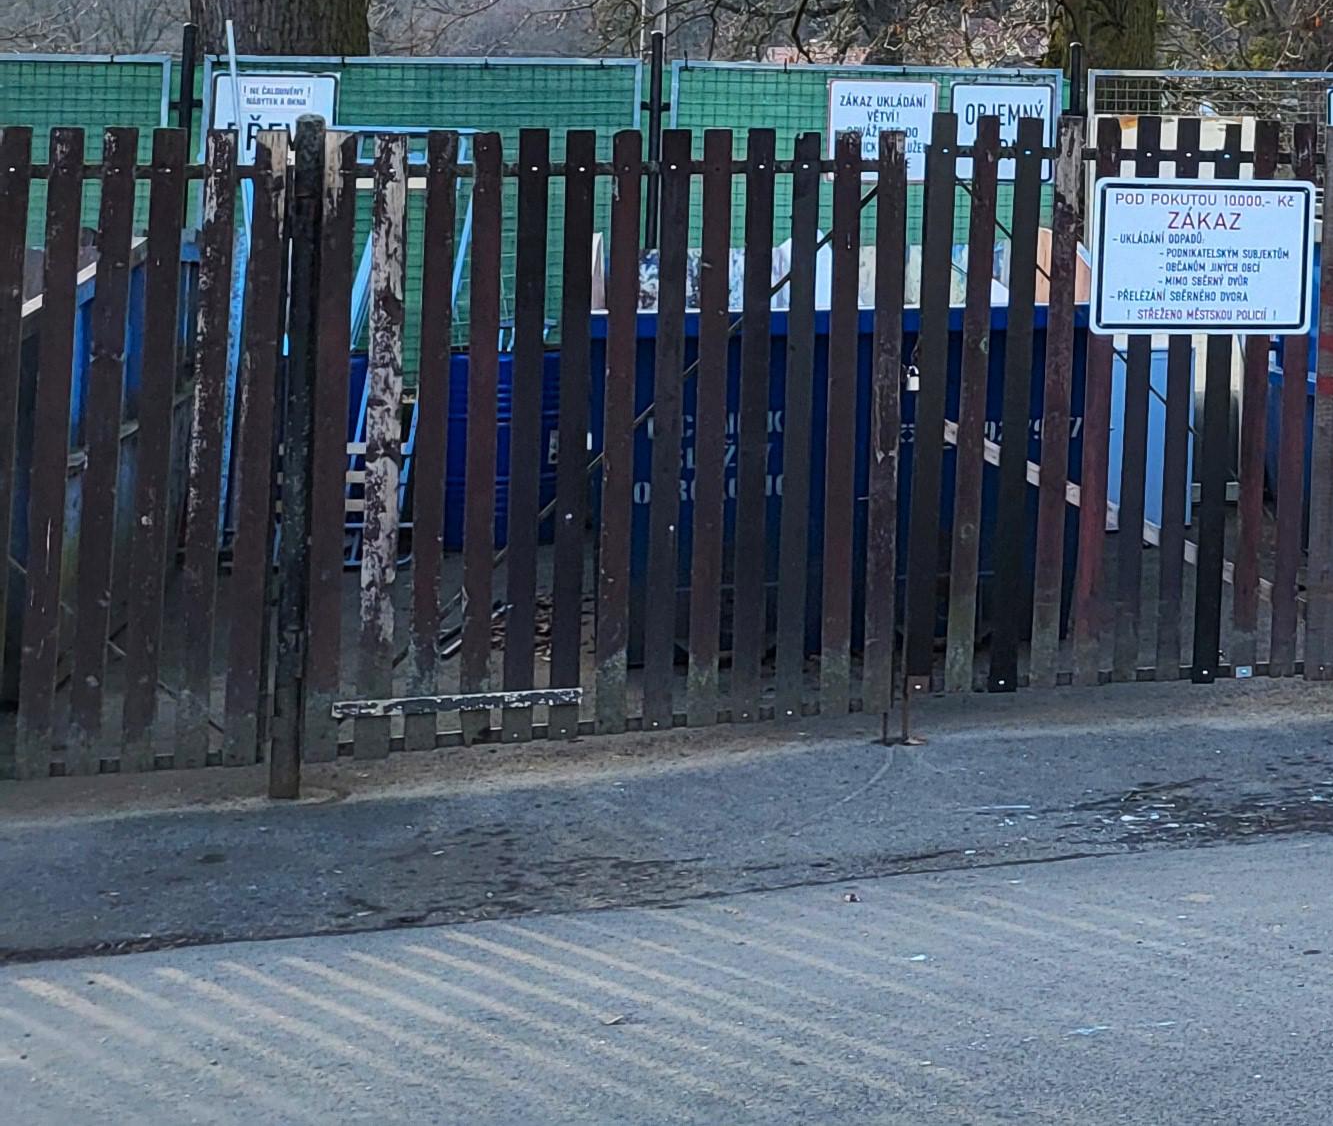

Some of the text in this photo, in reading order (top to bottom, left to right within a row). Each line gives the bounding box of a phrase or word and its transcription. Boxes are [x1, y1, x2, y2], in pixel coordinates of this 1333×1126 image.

[246, 95, 306, 106] NÁBYTEK A OKNA
[840, 92, 927, 108] ZÁKAZ UKLÁDÁNÍ
[867, 108, 899, 123] VĚTVÍ!
[1115, 193, 1145, 206] POD
[1151, 193, 1217, 206] POKUTOU
[1278, 195, 1295, 207] Kč
[1167, 207, 1242, 231] ZÁKAZ
[1120, 232, 1165, 244] UKLÁDÁNÍ
[1166, 247, 1239, 259] PODNIKATELSKÝM
[1242, 249, 1289, 259] SUBJEKTŮM
[1166, 262, 1206, 273] OBČANŮM
[1210, 262, 1238, 273] JINÝCH
[1165, 276, 1188, 286] MIMO
[1191, 274, 1224, 286] SBĚRNÝ
[1228, 274, 1249, 286] DVŮR
[1117, 289, 1166, 301] PŘELÉZÁNÍ
[1170, 290, 1216, 301] SBĚRNÉHO
[1220, 293, 1248, 302] DVORA
[1137, 308, 1182, 320] STŘEŽENO
[1186, 309, 1233, 321] MĚSTSKOU
[1236, 309, 1267, 321] POLICIÍ
